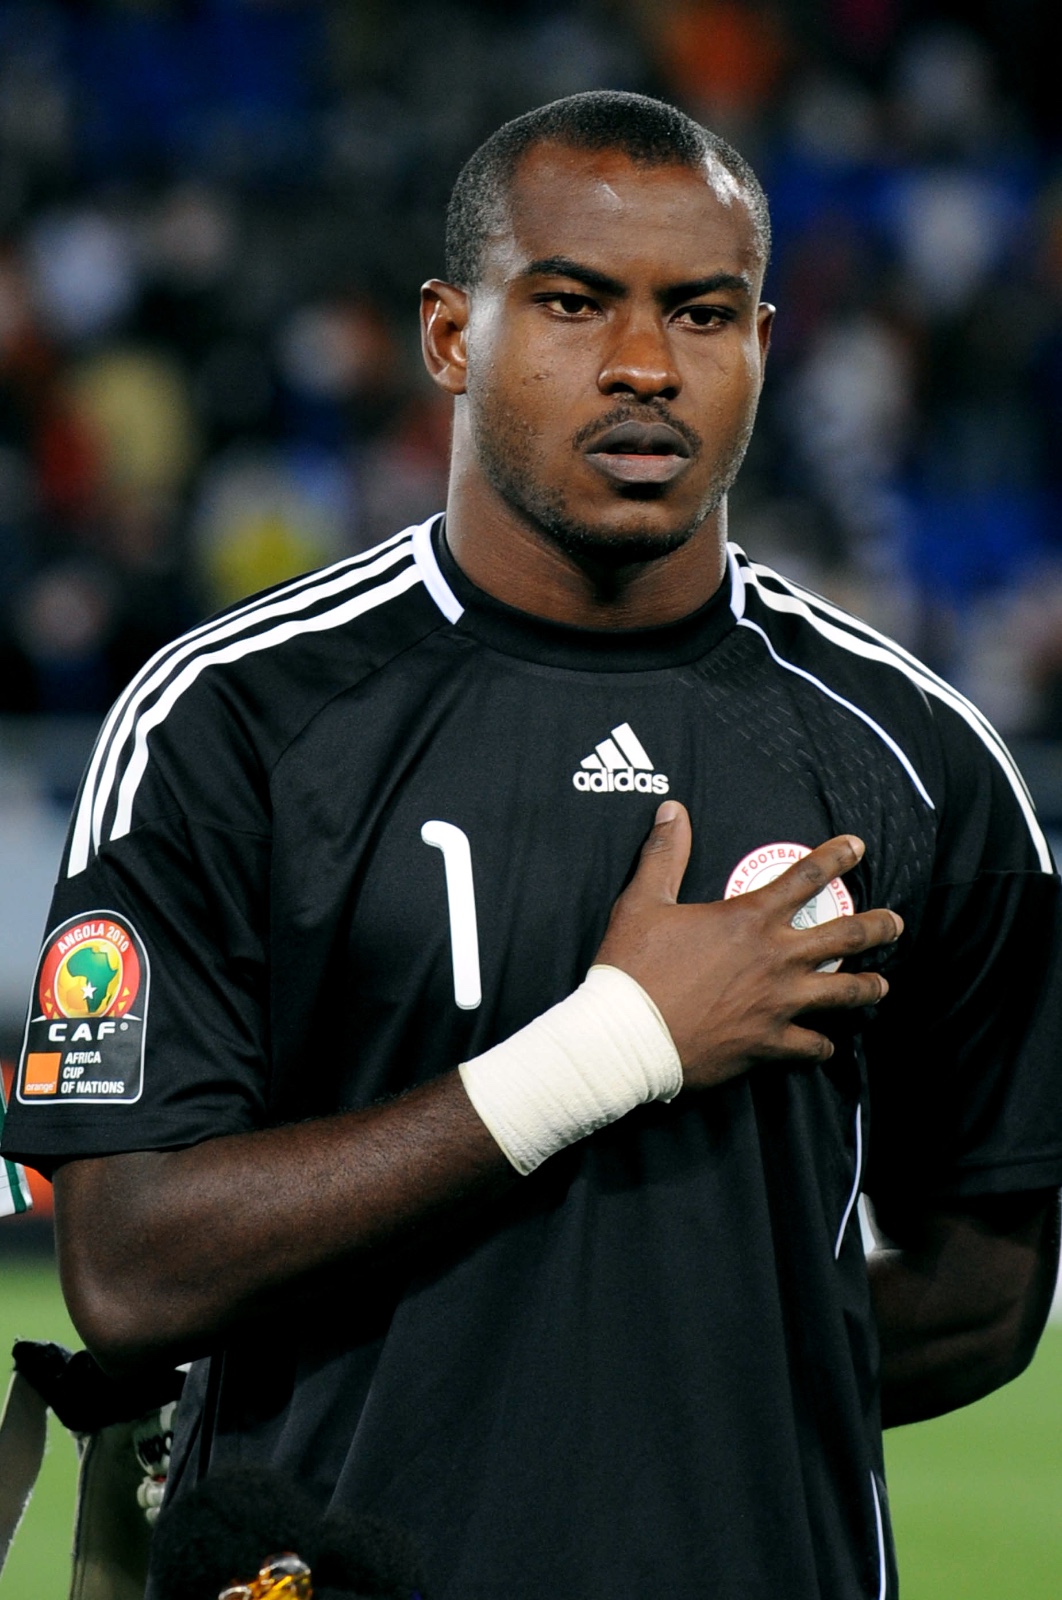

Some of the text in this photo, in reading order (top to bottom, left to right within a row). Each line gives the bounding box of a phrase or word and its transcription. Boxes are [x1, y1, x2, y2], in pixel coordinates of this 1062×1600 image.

[573, 766, 670, 795] adidas
[421, 820, 482, 1010] 1
[57, 923, 130, 954] ANGOLA 2010
[48, 1022, 116, 1042] CAF
[65, 1051, 101, 1064] AFRICA
[63, 1066, 84, 1079] CUP
[26, 1083, 54, 1093] orange
[61, 1081, 125, 1094] OF NATIONS
